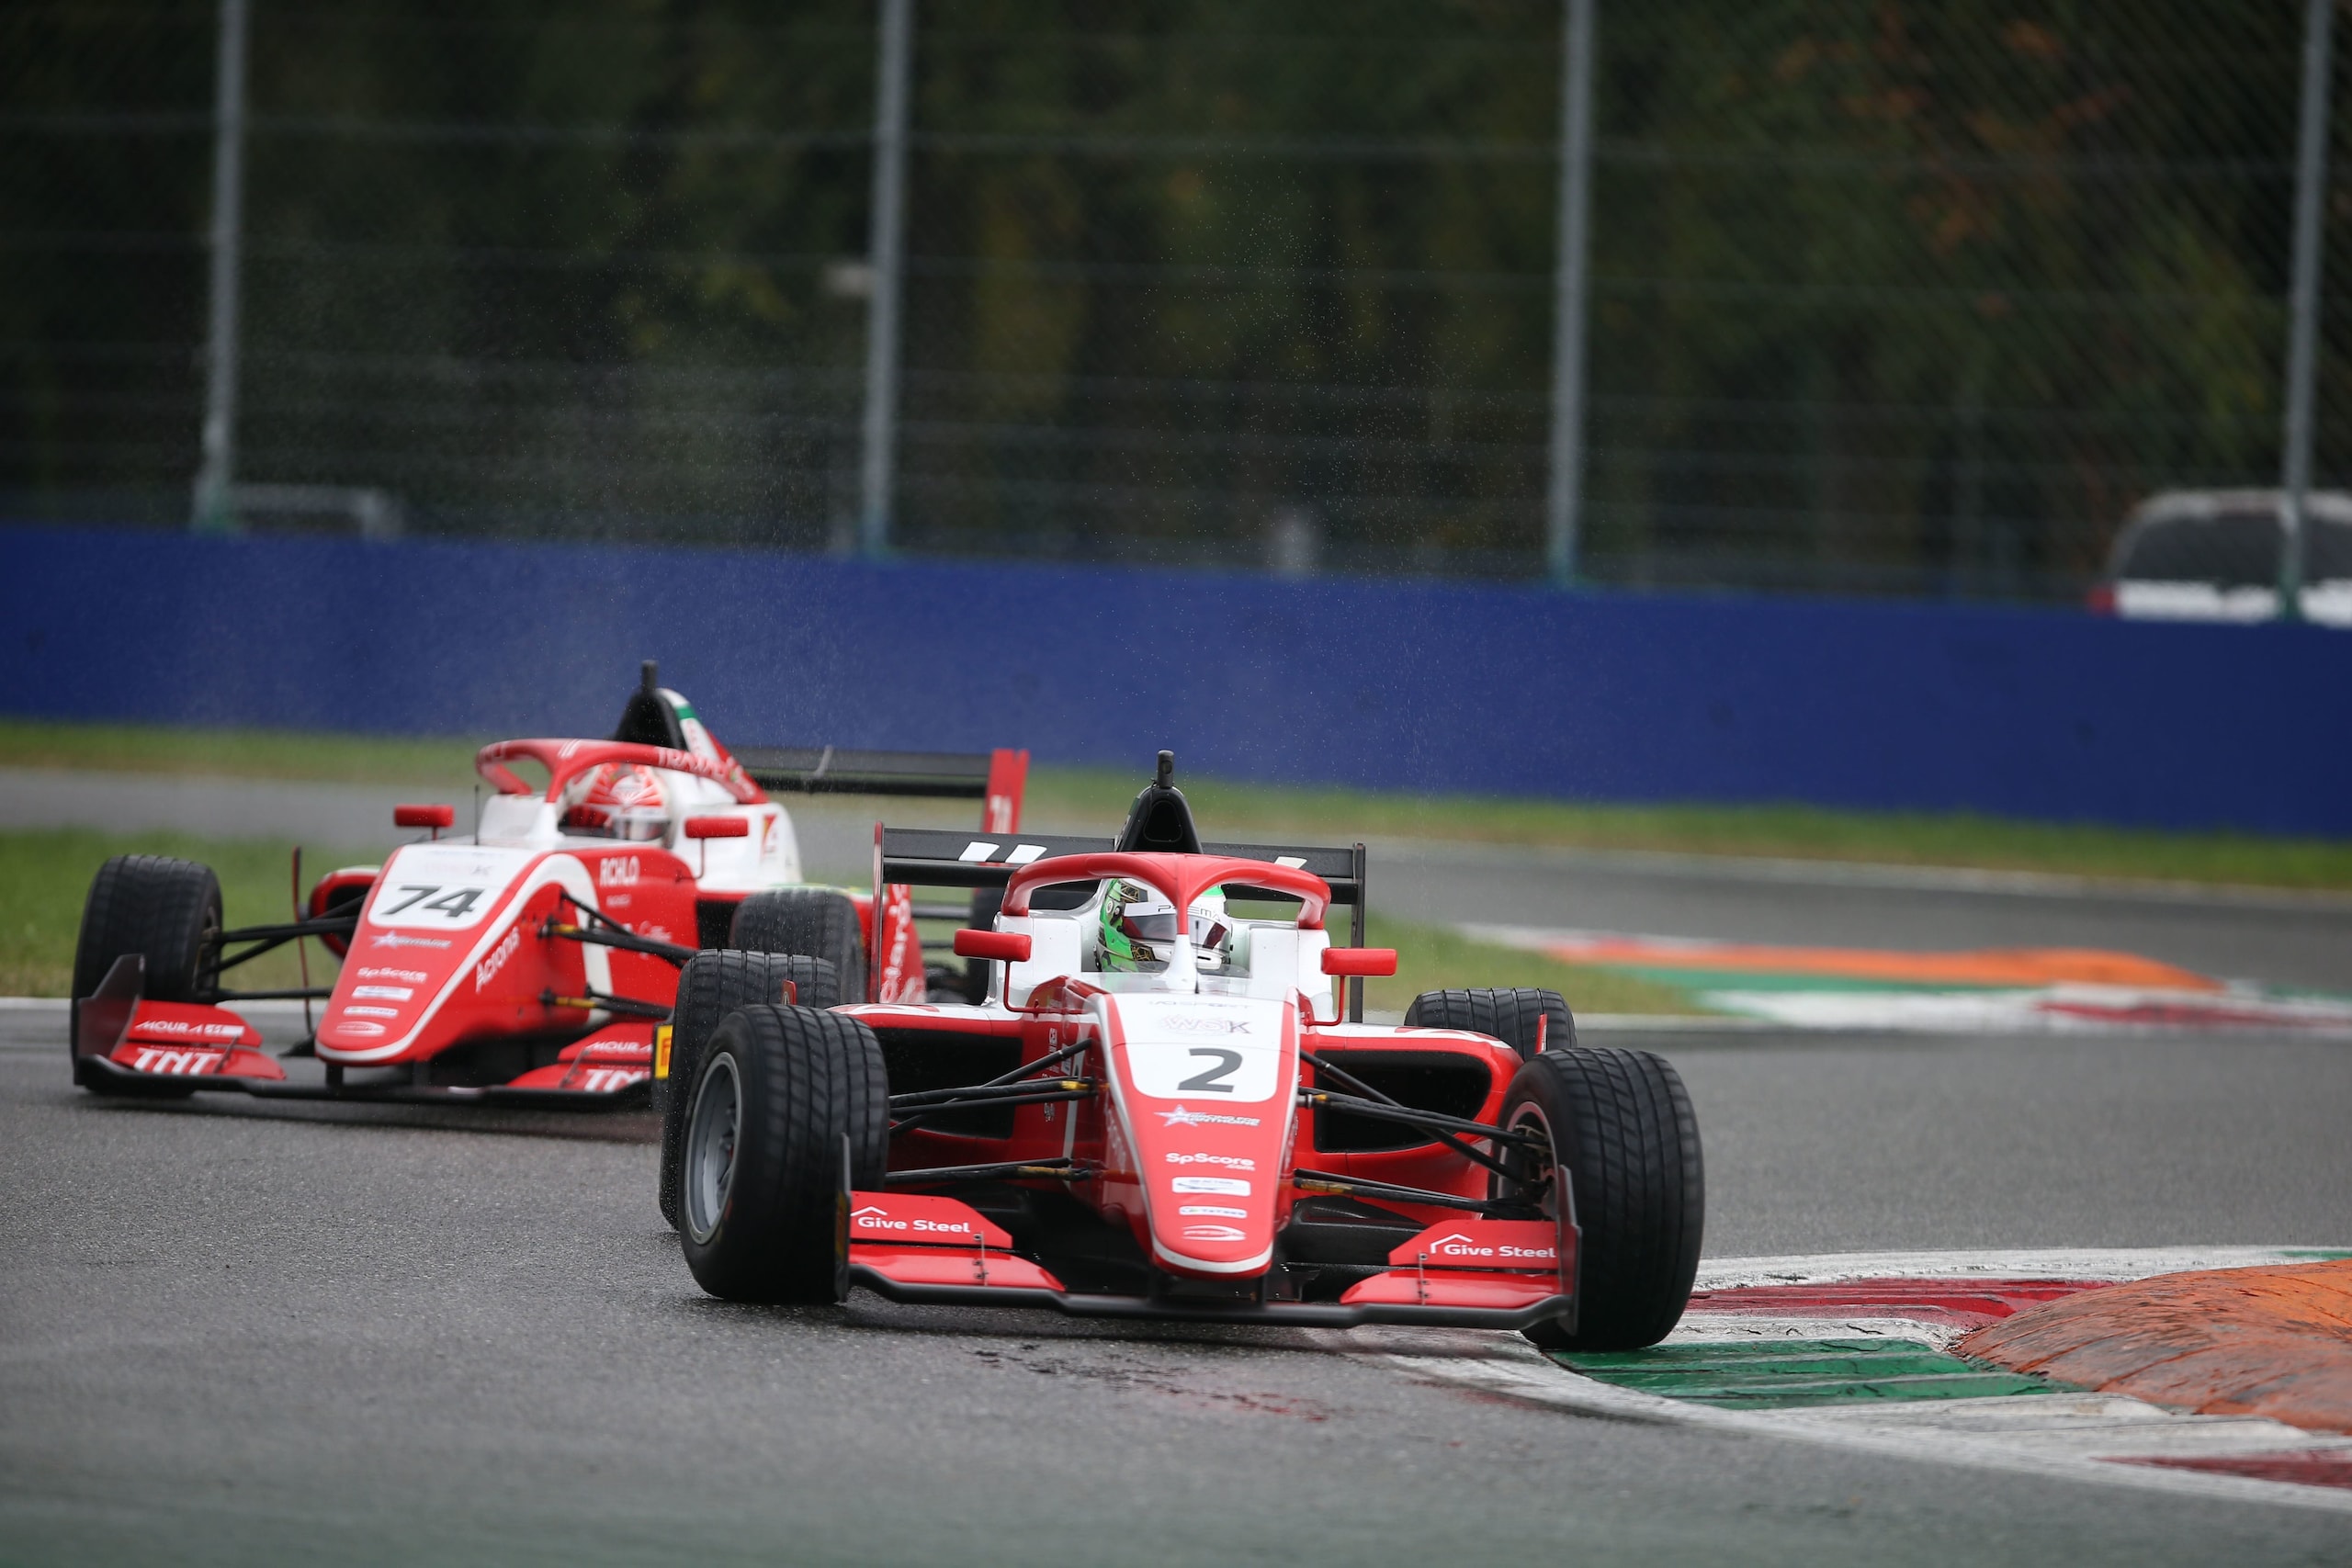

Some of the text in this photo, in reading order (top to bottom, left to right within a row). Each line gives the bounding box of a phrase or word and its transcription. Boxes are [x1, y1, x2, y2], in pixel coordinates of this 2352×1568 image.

[599, 855, 640, 887] RCHLO
[380, 885, 485, 919] 74
[475, 926, 521, 994] Acronis
[135, 1021, 202, 1036] MOURA
[134, 1047, 223, 1076] TNT
[1177, 1047, 1244, 1093] 2
[583, 1069, 651, 1093] TN
[1165, 1152, 1255, 1165] SpScore
[857, 1216, 971, 1234] Give Steel
[1443, 1244, 1556, 1258] Give Steel
